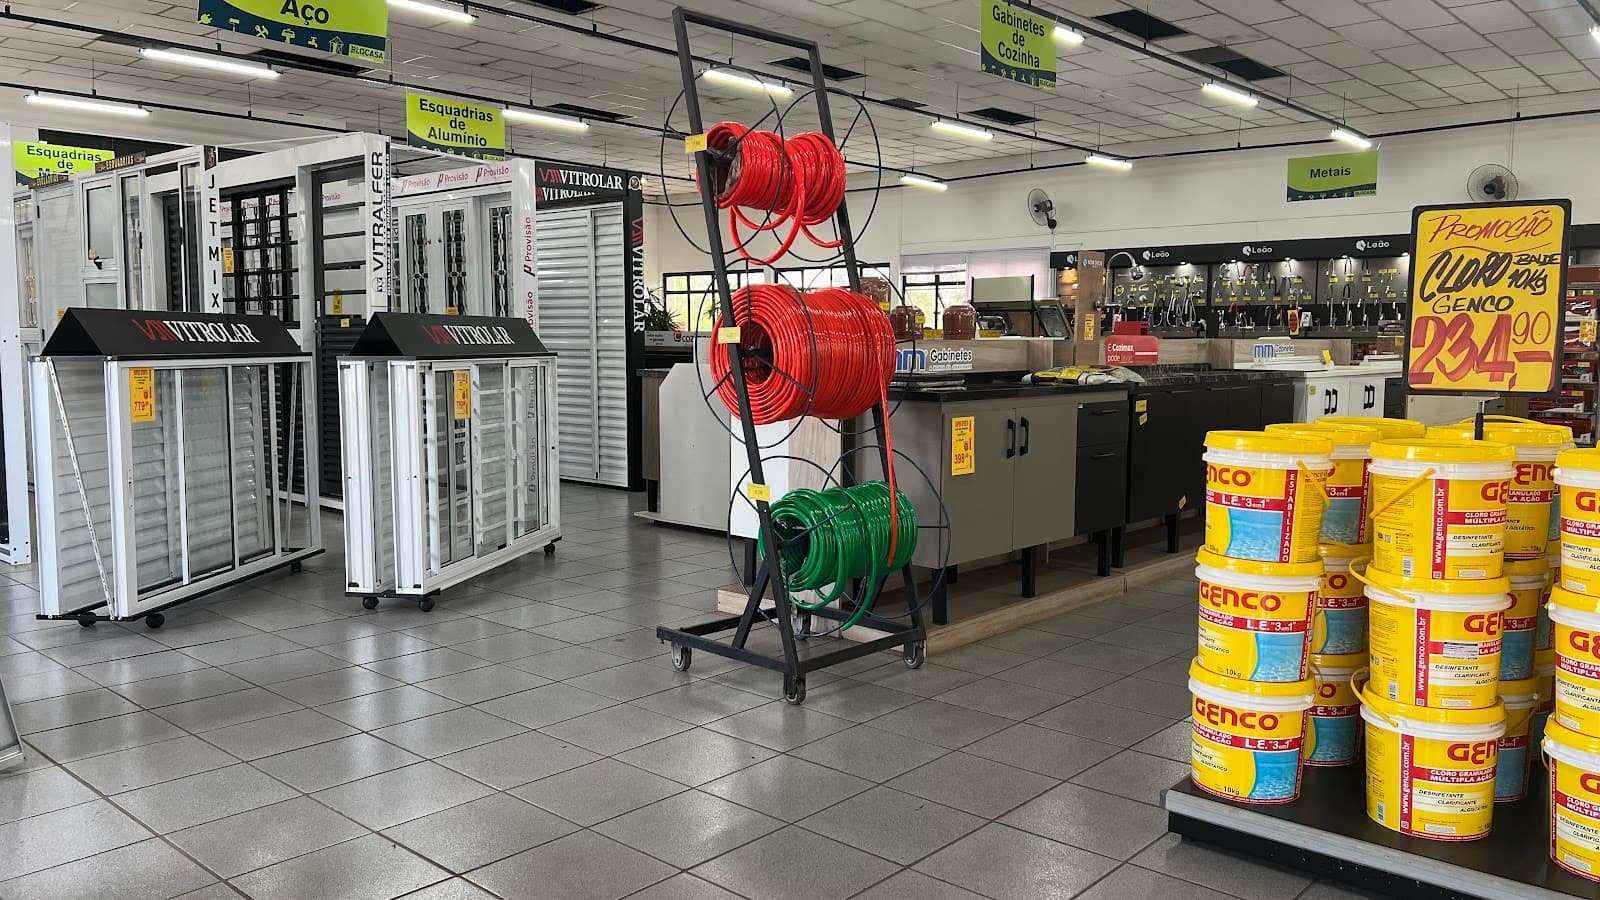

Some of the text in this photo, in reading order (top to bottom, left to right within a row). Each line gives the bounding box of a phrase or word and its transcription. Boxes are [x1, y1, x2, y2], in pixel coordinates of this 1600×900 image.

[280, 0, 330, 25] Aço
[992, 4, 1046, 37] Gabinetes
[1012, 29, 1026, 47] de
[350, 46, 385, 61] BLOCASA
[998, 41, 1041, 69] Cozinha
[419, 97, 494, 123] Esquadrias
[449, 117, 466, 131] de
[427, 126, 488, 148] Alumínio
[27, 144, 102, 162] Esquadrias
[57, 159, 74, 170] de
[1309, 166, 1352, 180] Metais
[371, 151, 385, 272] VITRALFER
[1427, 210, 1553, 244] PROMOÇÃO
[524, 216, 535, 263] Provisão
[1367, 241, 1391, 249] Leão
[1419, 249, 1514, 303] CLORO
[1432, 295, 1515, 315] GENCO
[162, 320, 261, 343] VITROLAR
[443, 325, 516, 345] VITROLAR
[930, 348, 973, 363] Gabinetes
[1281, 475, 1295, 563] ESTABILIZADO
[1434, 487, 1446, 564] www.genco.com.br
[1200, 580, 1282, 613] GENCO
[1246, 619, 1269, 632] L.E.
[1417, 617, 1428, 692] www.genco.com.br
[1195, 697, 1280, 732] GENCO
[1245, 741, 1269, 751] L.E.
[1402, 742, 1412, 815] www.genco.com.br
[1430, 769, 1457, 777] CLORO
[1223, 786, 1240, 796] 10kg
[1566, 797, 1590, 809] CLORO
